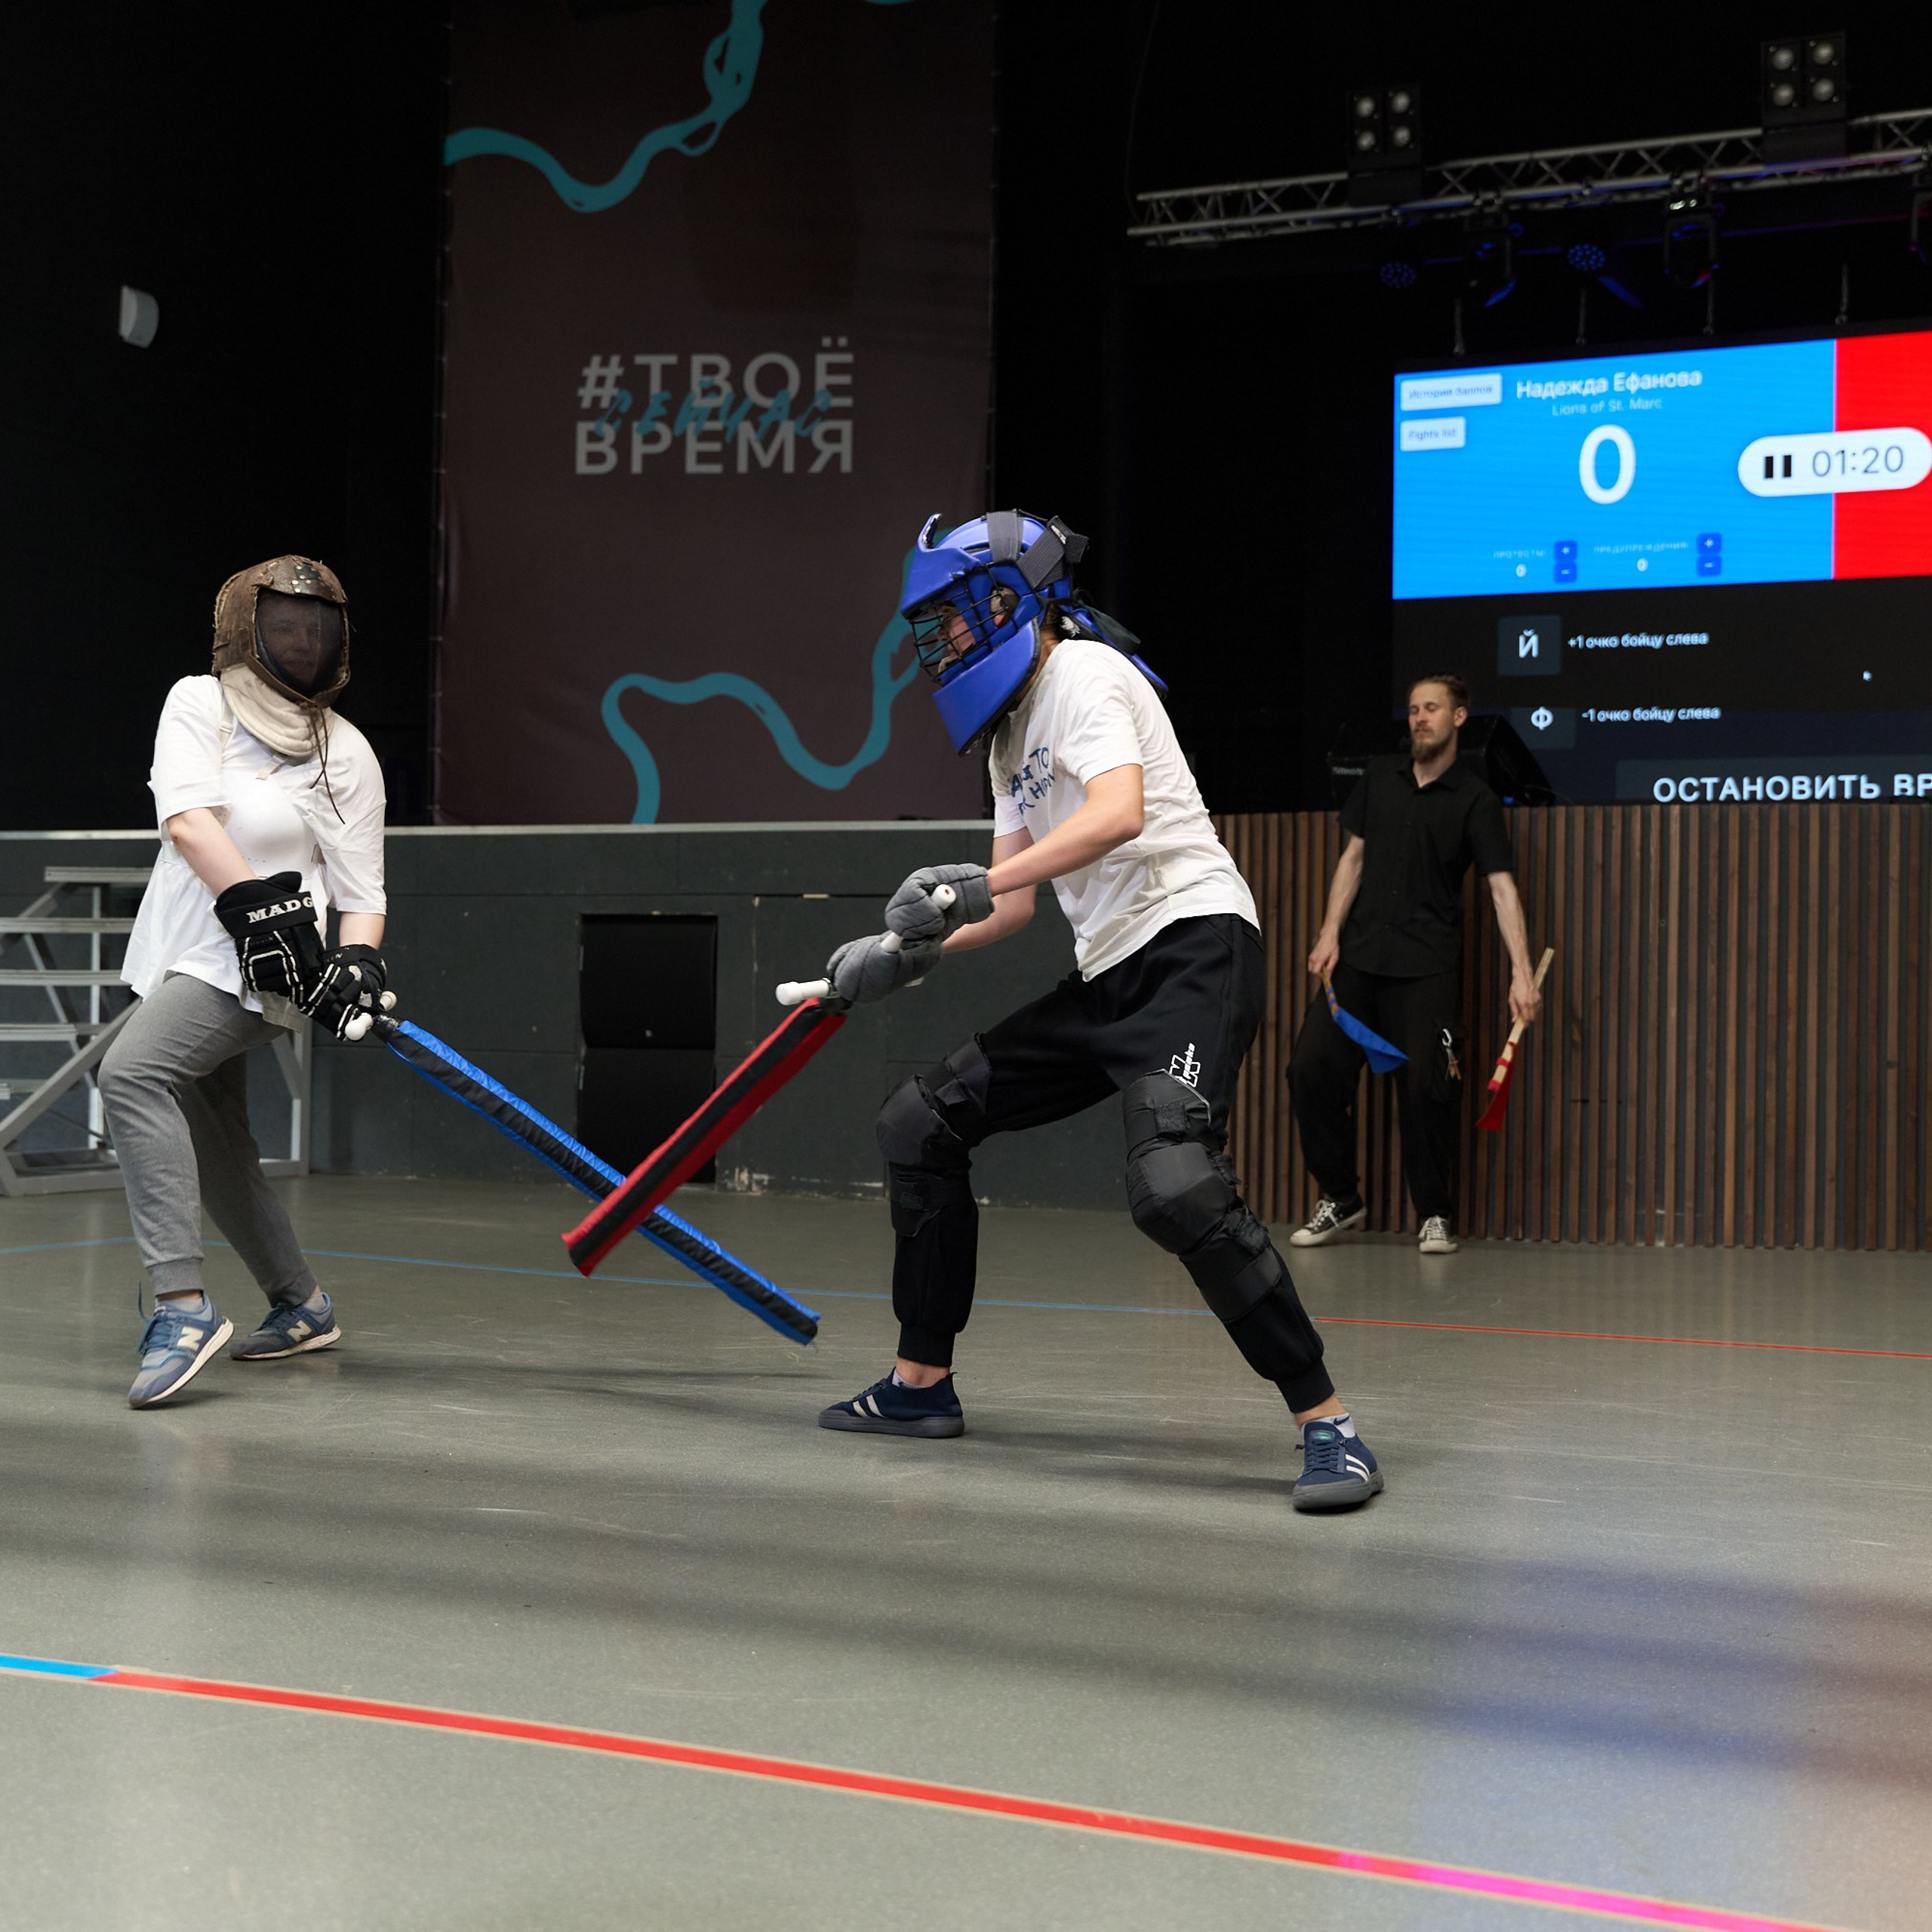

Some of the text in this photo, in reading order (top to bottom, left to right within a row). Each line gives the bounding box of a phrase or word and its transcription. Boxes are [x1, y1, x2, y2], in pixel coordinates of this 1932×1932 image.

[577, 336, 854, 409] #ТВОЁ
[1517, 371, 1703, 399] Надежда Ефанова
[594, 376, 832, 443] СЕЙЧАС
[1552, 404, 1587, 416] Lions
[1590, 399, 1606, 414] of
[1629, 397, 1663, 411] Marc
[575, 420, 854, 475] ВРЕМЯ
[1812, 446, 1904, 477] 01:20
[1579, 424, 1636, 505] 0
[1518, 629, 1539, 658] Й
[1567, 632, 1709, 649] +1 очко бойцу слева
[1531, 706, 1553, 731] Ф
[1597, 710, 1632, 723] очко
[1633, 706, 1676, 723] бойцу
[1678, 706, 1721, 721] слева
[1653, 774, 1881, 802] ОСТАНОВИТЬ
